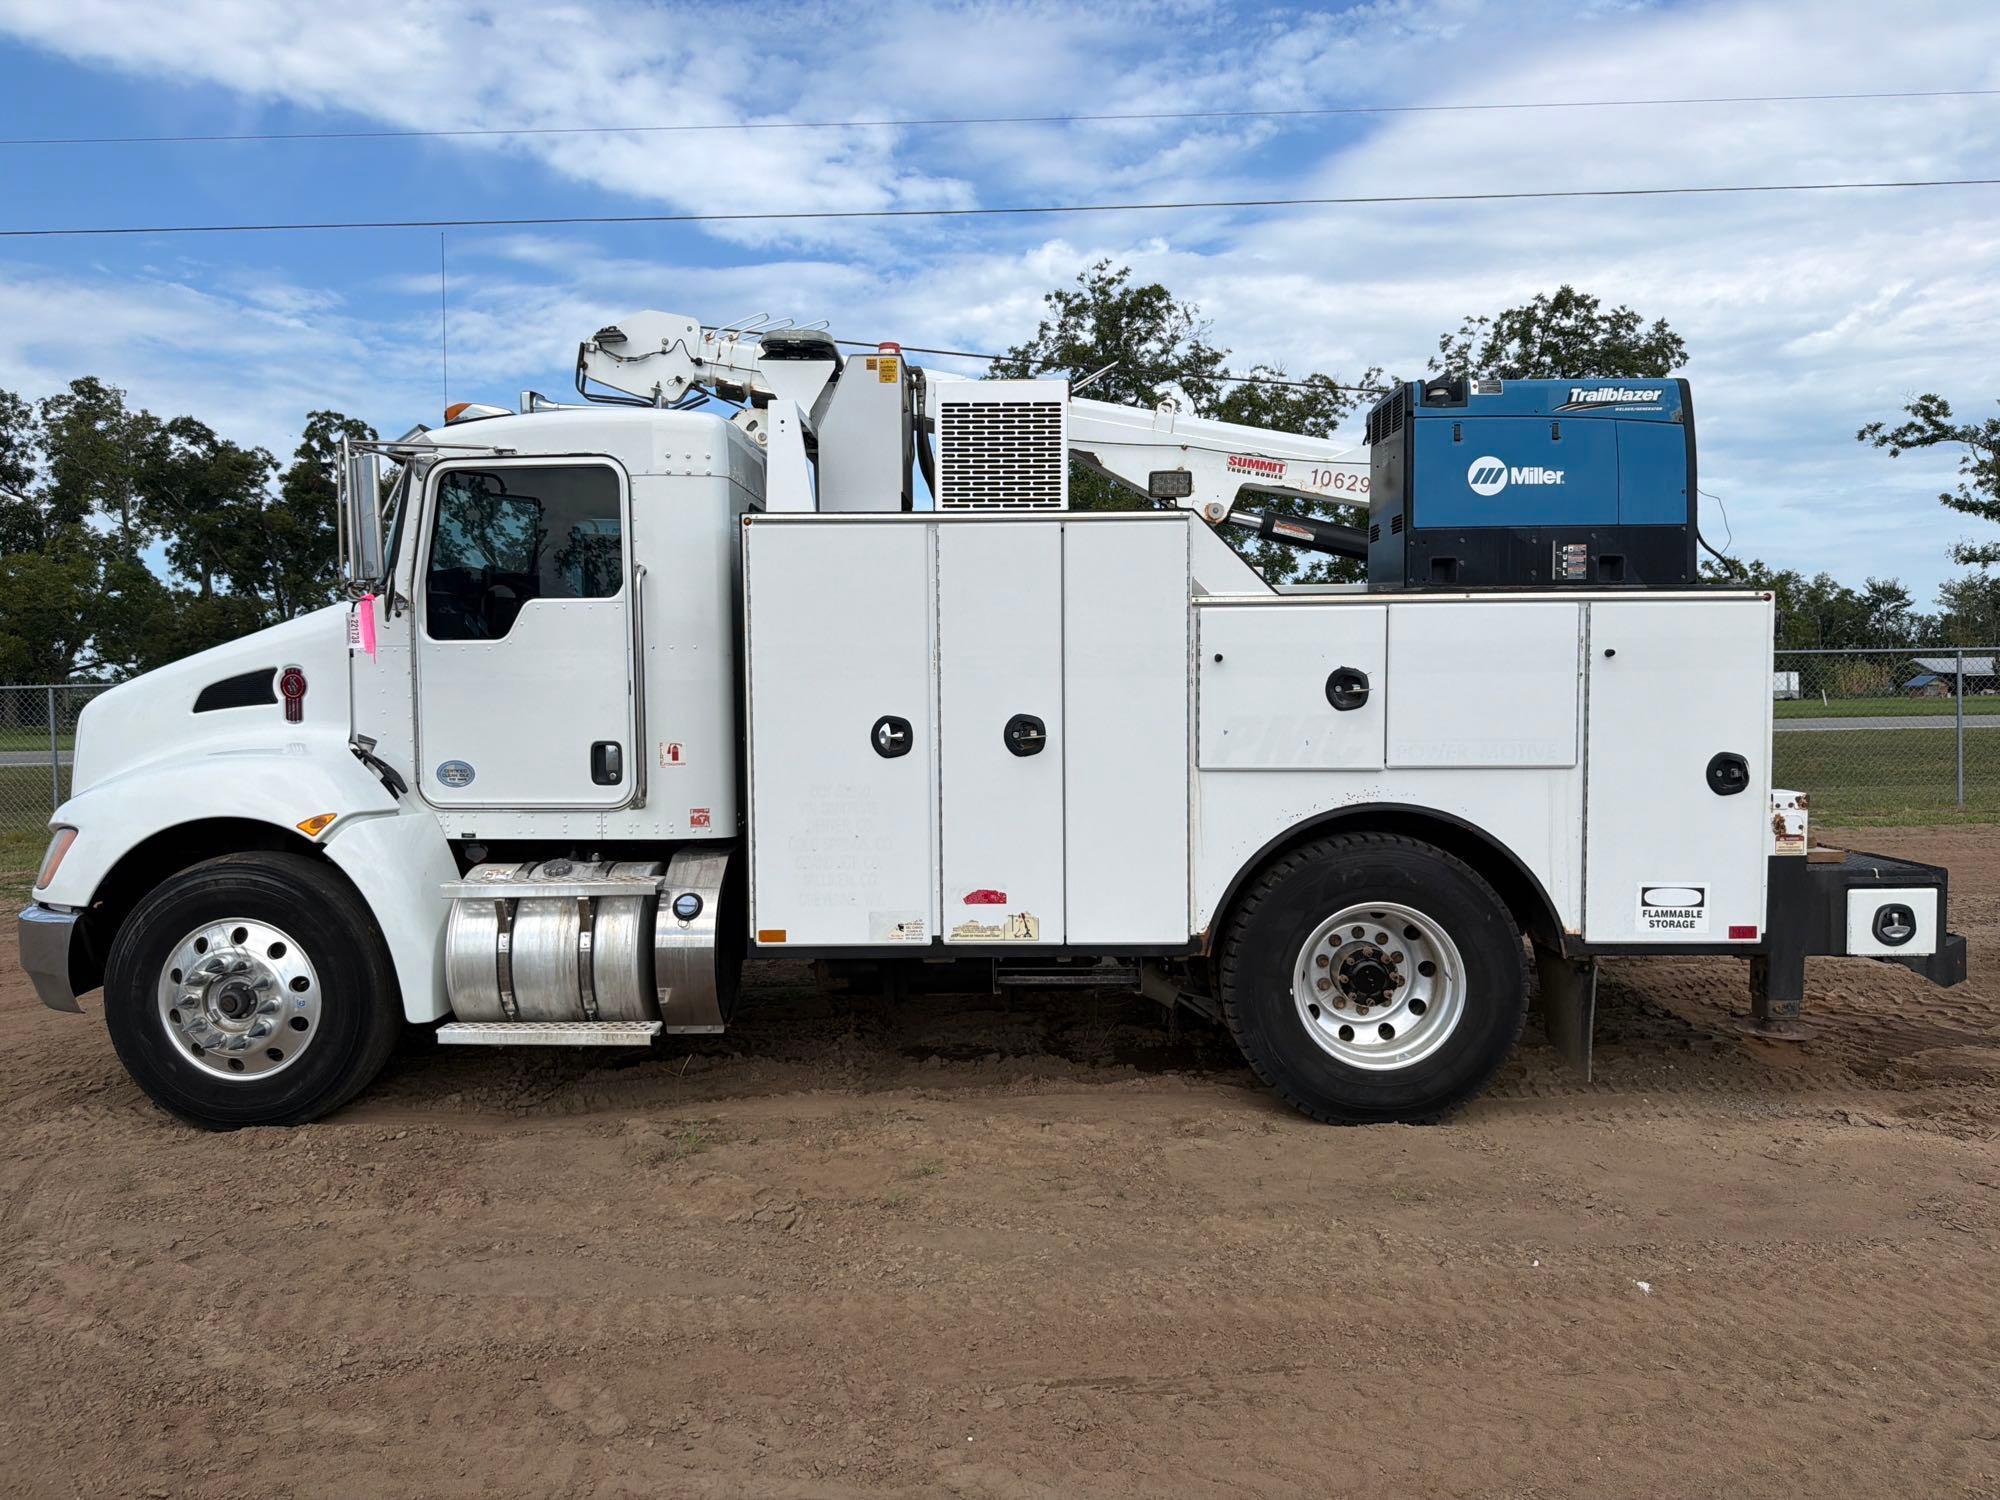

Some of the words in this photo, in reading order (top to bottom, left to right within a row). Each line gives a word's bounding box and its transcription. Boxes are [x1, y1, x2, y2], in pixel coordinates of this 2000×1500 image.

[1569, 387, 1662, 402] Trailblazer
[1228, 455, 1286, 474] SUMMIT
[1227, 466, 1251, 475] TRUCK
[1255, 470, 1283, 480] BODIES
[1311, 468, 1370, 493] 10629
[1511, 466, 1564, 485] Miller
[1642, 910, 1703, 919] FLAMMABLE
[1648, 919, 1696, 929] STORAGE
